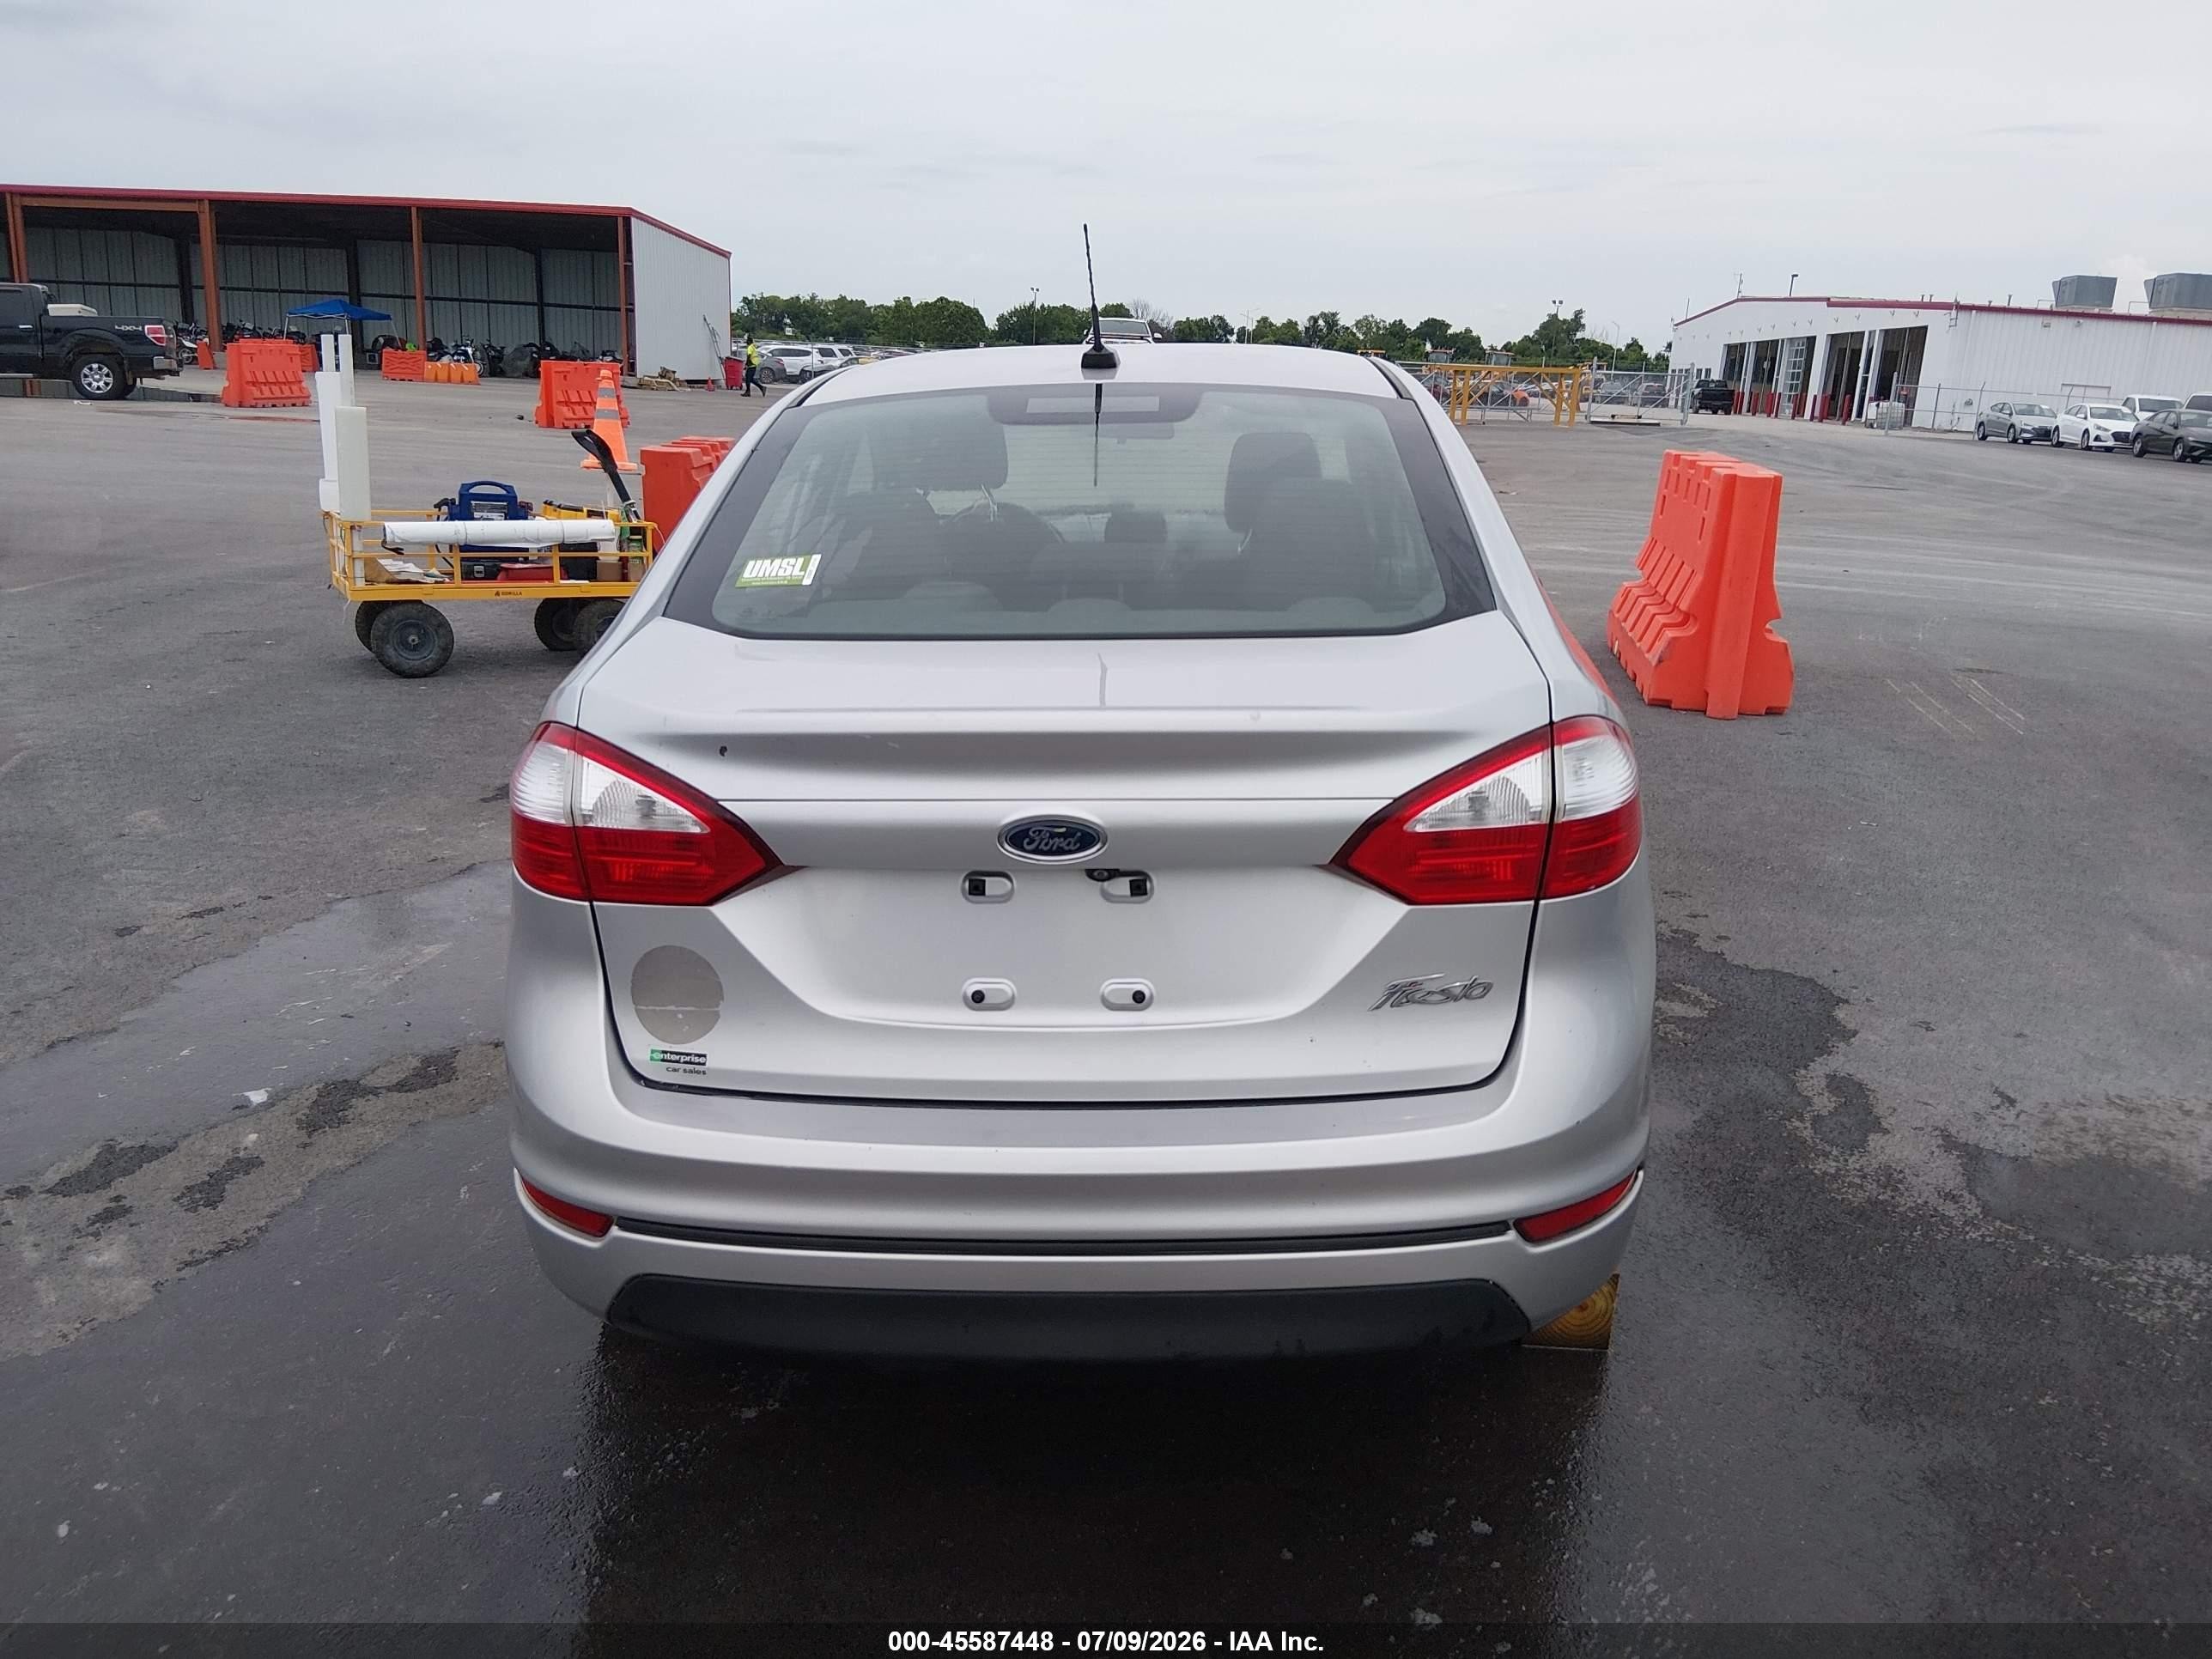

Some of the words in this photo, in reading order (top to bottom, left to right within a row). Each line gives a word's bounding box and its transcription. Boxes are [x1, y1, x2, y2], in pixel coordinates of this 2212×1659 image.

[742, 557, 805, 578] UMSL
[1023, 825, 1082, 852] Ford
[1367, 972, 1494, 1012] Fiesta
[652, 1051, 707, 1063] enterprise
[683, 1066, 707, 1075] sales
